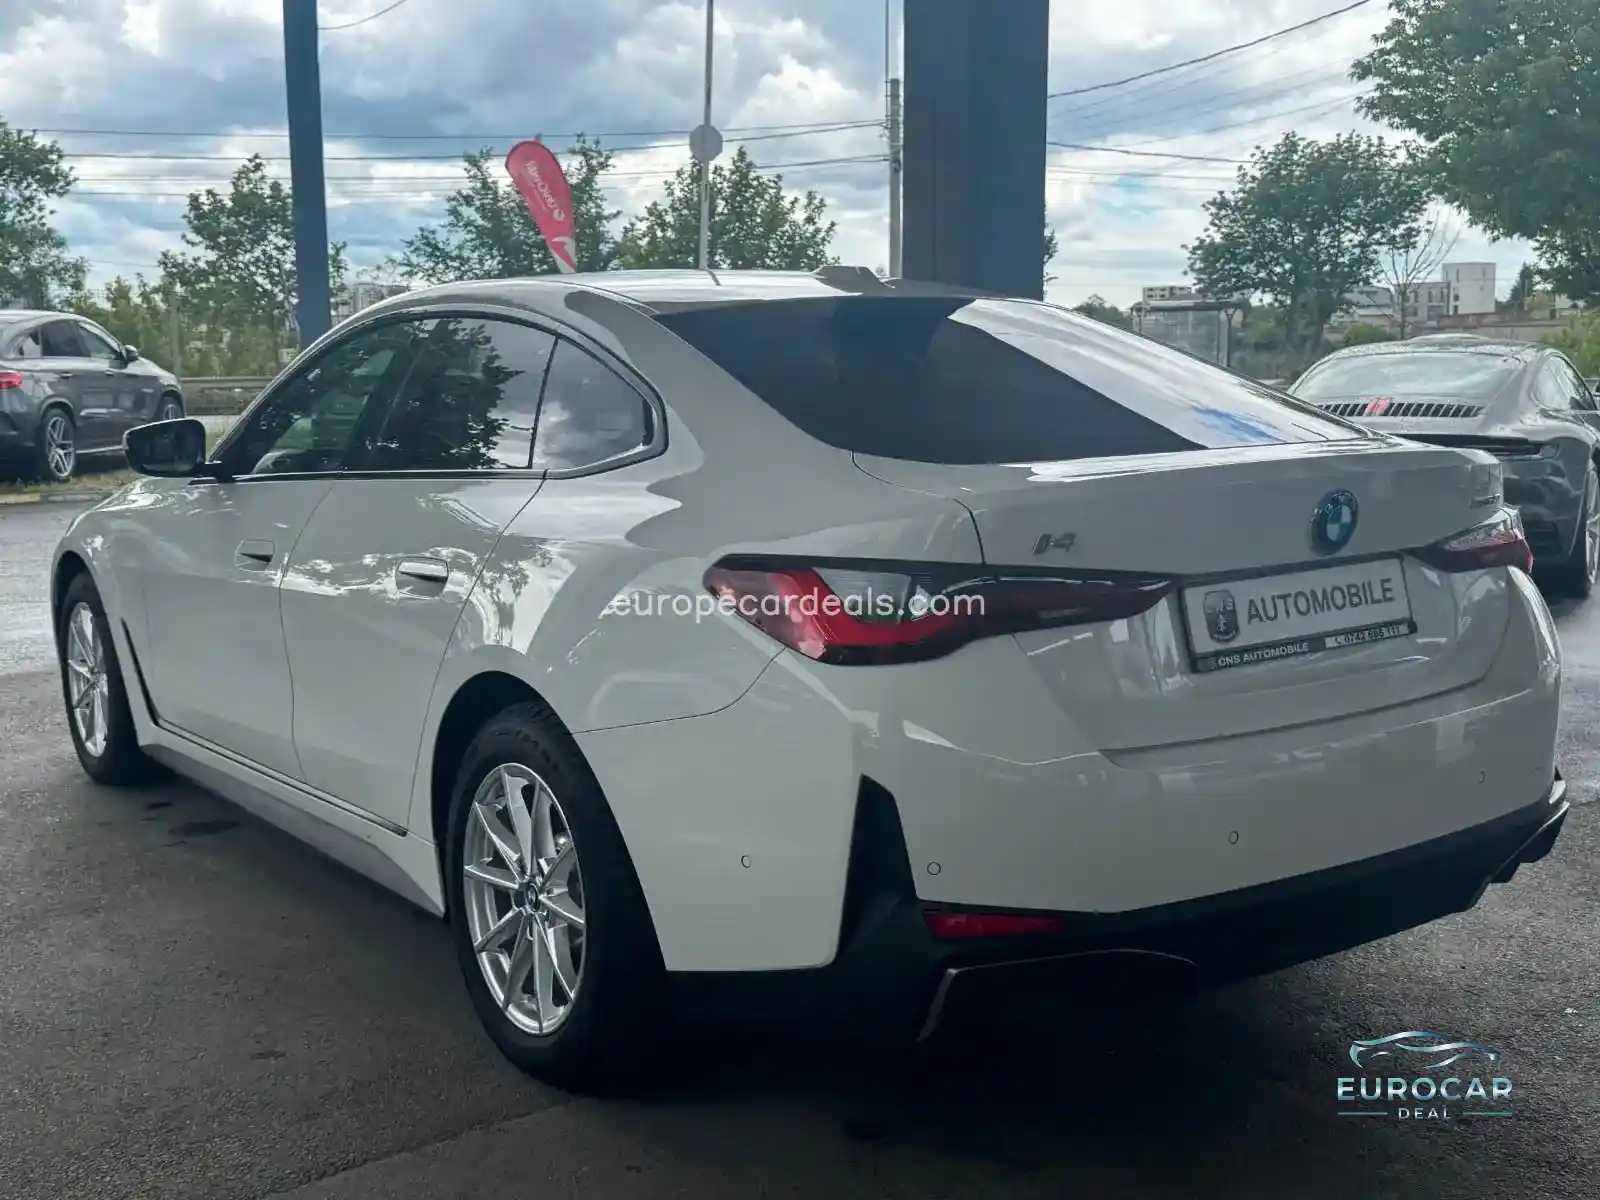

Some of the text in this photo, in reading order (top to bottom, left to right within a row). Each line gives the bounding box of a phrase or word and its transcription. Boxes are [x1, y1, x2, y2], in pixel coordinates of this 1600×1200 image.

[1033, 532, 1076, 555] i4
[1247, 577, 1396, 625] AUTOMOBILE
[1218, 641, 1309, 667] CNS AUTOMOBILE
